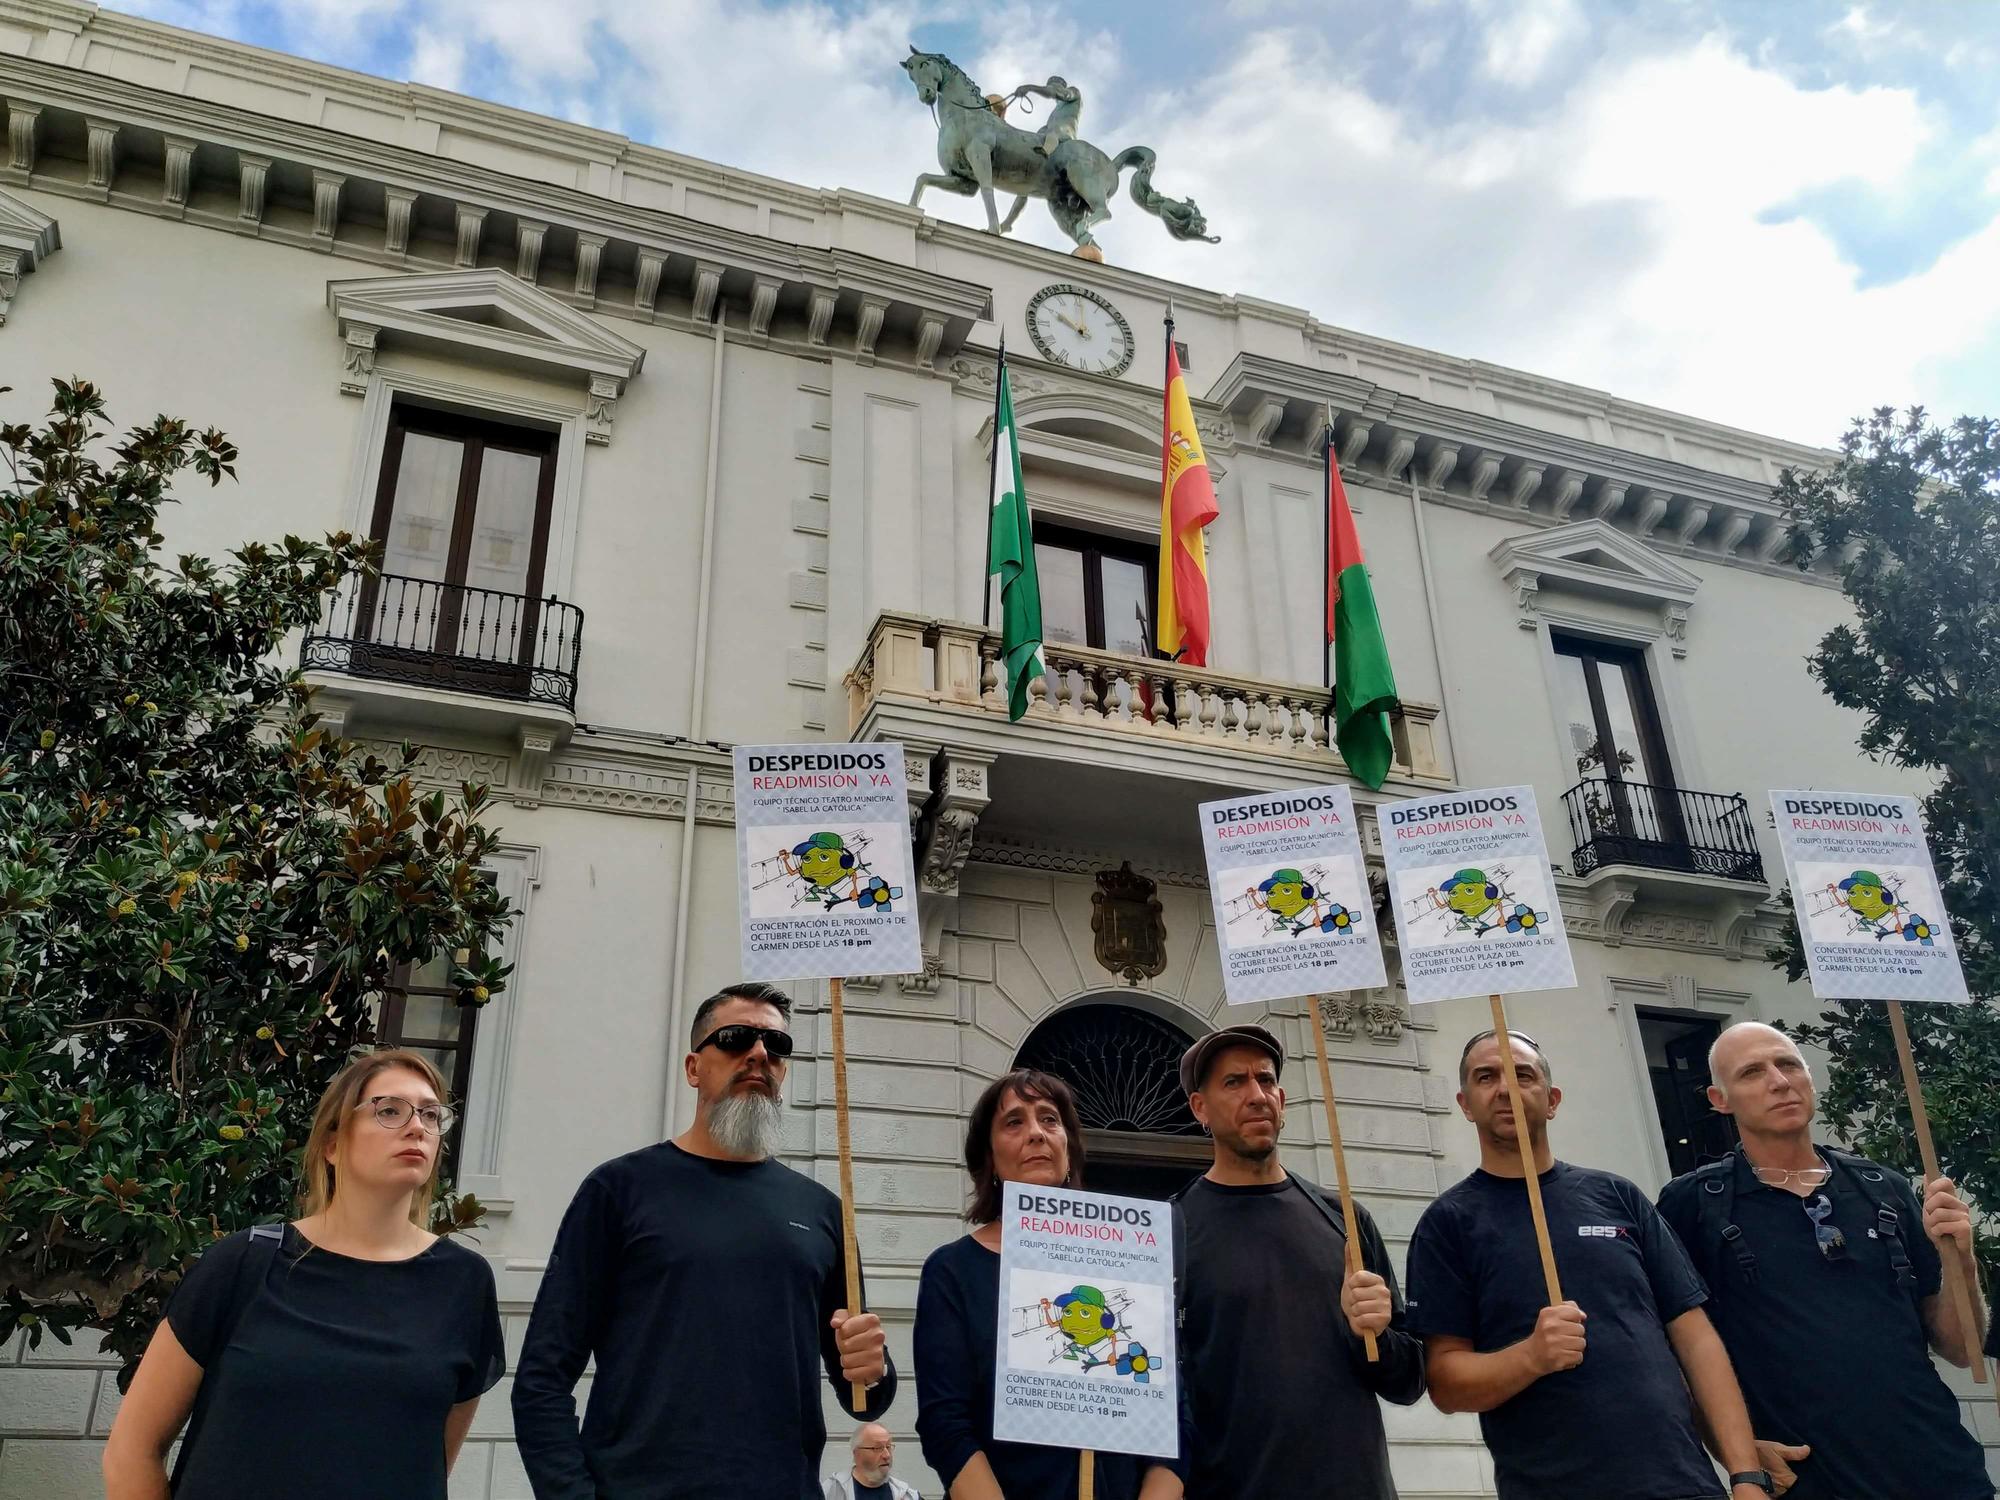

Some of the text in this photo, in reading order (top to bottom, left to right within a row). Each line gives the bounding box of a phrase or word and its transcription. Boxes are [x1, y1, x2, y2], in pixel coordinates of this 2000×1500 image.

[1030, 284, 1072, 308] PRESENTE
[1126, 348, 1134, 360] VE
[1114, 358, 1129, 374] SUS
[748, 754, 886, 773] DESPEDIDOS
[753, 771, 891, 790] READMISIÓN YA
[753, 798, 783, 806] EQUIPO
[784, 796, 820, 804] TÉCNICO
[1212, 795, 1334, 825] DESPEDIDOS
[1390, 796, 1517, 825] DESPEDIDOS
[1785, 799, 1904, 820] DESPEDIDOS
[1218, 813, 1341, 839] READMISIÓN YA
[1397, 813, 1525, 839] READMISIÓN YA
[1793, 818, 1912, 835] READMISIÓN YA
[1220, 831, 1345, 853] EQUIPO TÉCNICO TEATRO MUNICIPAL
[1399, 831, 1530, 853] EQUIPO TÉCNICO TEATRO MUNICIPAL
[1823, 837, 1853, 846] TÉCNICO
[1854, 839, 1881, 847] TEATRO
[1882, 841, 1918, 849] MUNICIPAL
[750, 919, 829, 932] CONCENTRACIÓN
[831, 919, 841, 927] EL
[843, 917, 884, 926] PROXIMO
[894, 916, 906, 924] DE
[750, 928, 870, 942] OCTUBRE EN LA PLAZA DEL
[751, 942, 789, 952] CARMEN
[792, 940, 821, 949] DESDE
[823, 939, 839, 948] LAS
[857, 940, 872, 948] pm
[1228, 945, 1297, 960] CONCENTRACIÓN
[1310, 939, 1347, 950] PROXIMO
[1356, 937, 1367, 945] DE
[1409, 945, 1481, 960] CONCENTRACIÓN
[1494, 940, 1533, 950] PROXIMO
[1543, 937, 1555, 945] DE
[1815, 946, 1882, 955] CONCENTRACIÓN
[1894, 949, 1929, 957] PROXIMO
[1230, 958, 1267, 969] OCTUBRE
[1293, 952, 1318, 961] PLAZA
[1320, 950, 1336, 958] DEL
[1411, 957, 1449, 968] OCTUBRE
[1477, 952, 1504, 960] PLAZA
[1505, 950, 1522, 958] DEL
[1412, 960, 1524, 977] CARMEN DESDE LAS 18 pm
[1817, 955, 1854, 963] OCTUBRE
[1878, 957, 1903, 965] PLAZA
[1819, 964, 1852, 972] CARMEN
[1854, 965, 1879, 973] DESDE
[1231, 967, 1265, 978] CARMEN
[1267, 963, 1292, 973] DESDE
[1294, 961, 1309, 970] LAS
[1324, 960, 1338, 968] pm
[1018, 1194, 1152, 1227] DESPEDIDOS
[1021, 1217, 1156, 1247] READMISIÓN YA
[1019, 1239, 1158, 1264] EQUIPO TÉCNICO TEATRO MUNICIPAL
[1074, 1255, 1084, 1263] LA
[1005, 1385, 1126, 1407] OCTUBRE EN LA PLAZA DEL
[1006, 1374, 1163, 1400] CONCENTRACIÓN EL PROXIMO 4 DE
[1005, 1397, 1127, 1418] CARMEN DESDE LAS 18 pm
